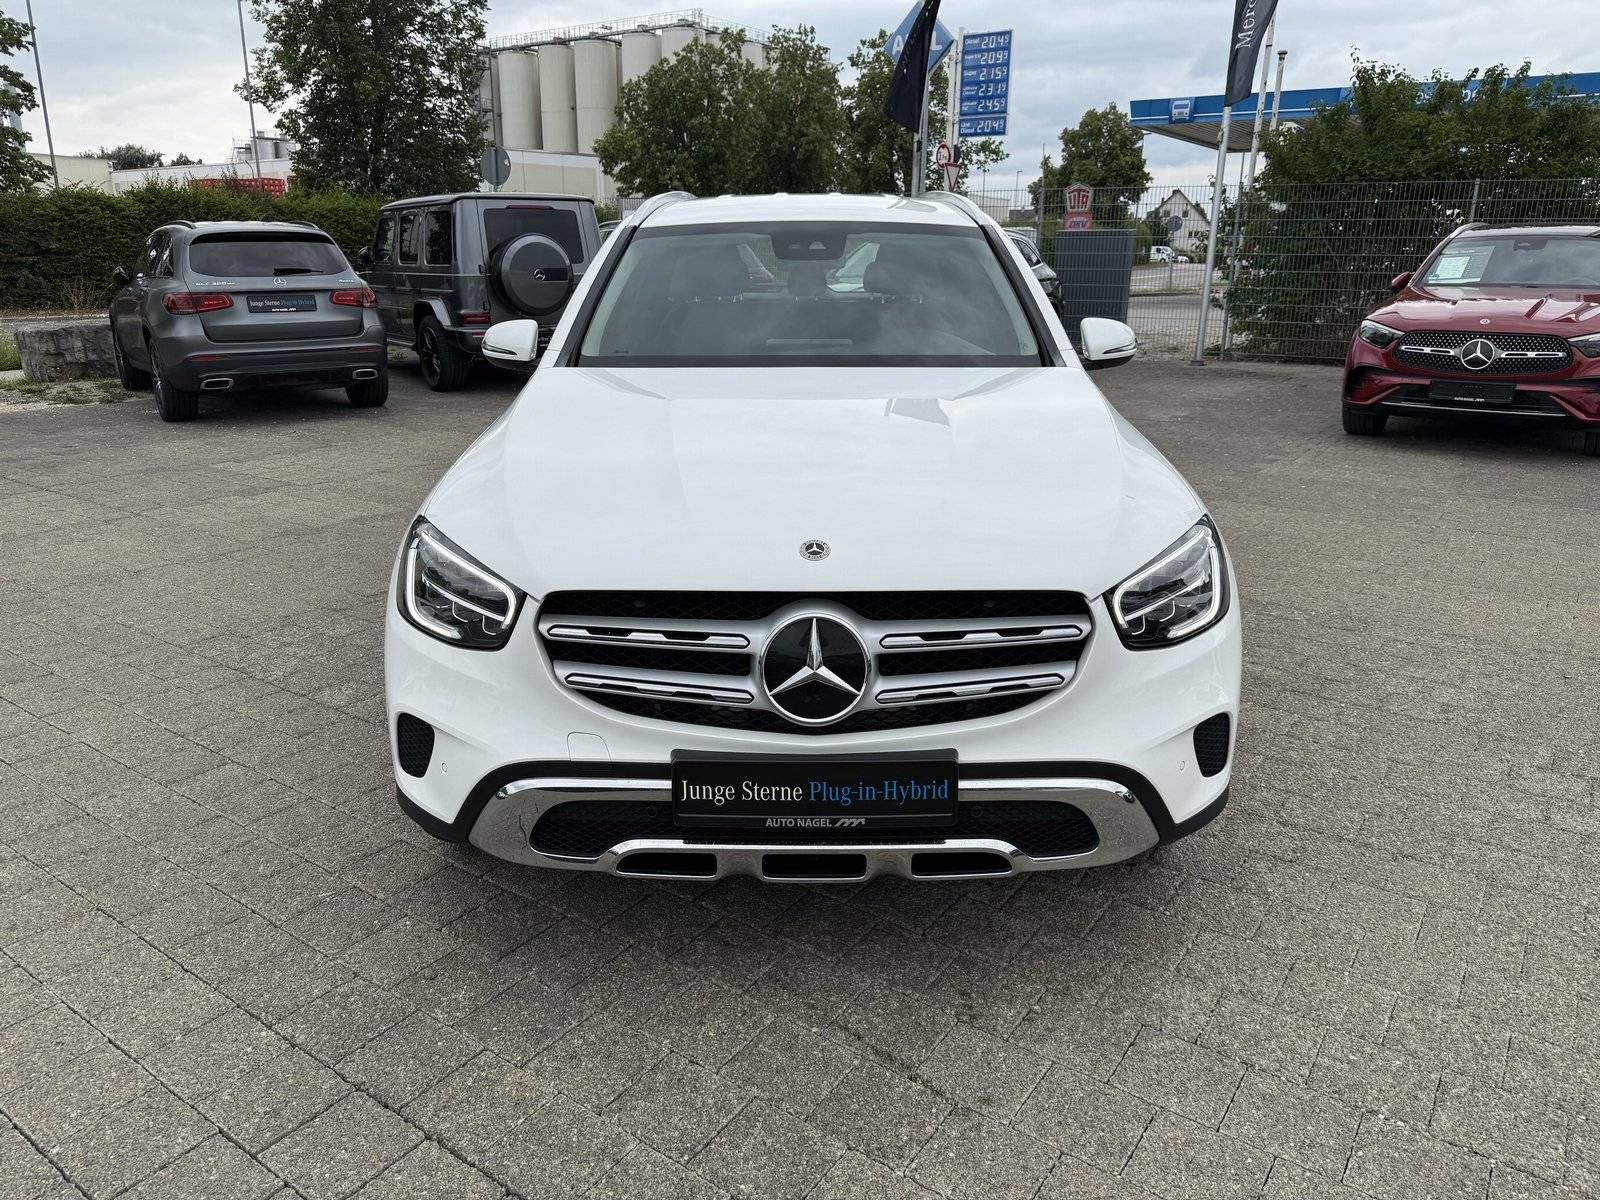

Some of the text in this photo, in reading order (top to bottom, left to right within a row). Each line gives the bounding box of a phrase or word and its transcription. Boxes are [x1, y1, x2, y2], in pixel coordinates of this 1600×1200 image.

[891, 31, 943, 55] AL
[681, 779, 950, 806] Junge Sterne Plug-in-Hybrid
[765, 818, 833, 828] AUTO NAGEL
